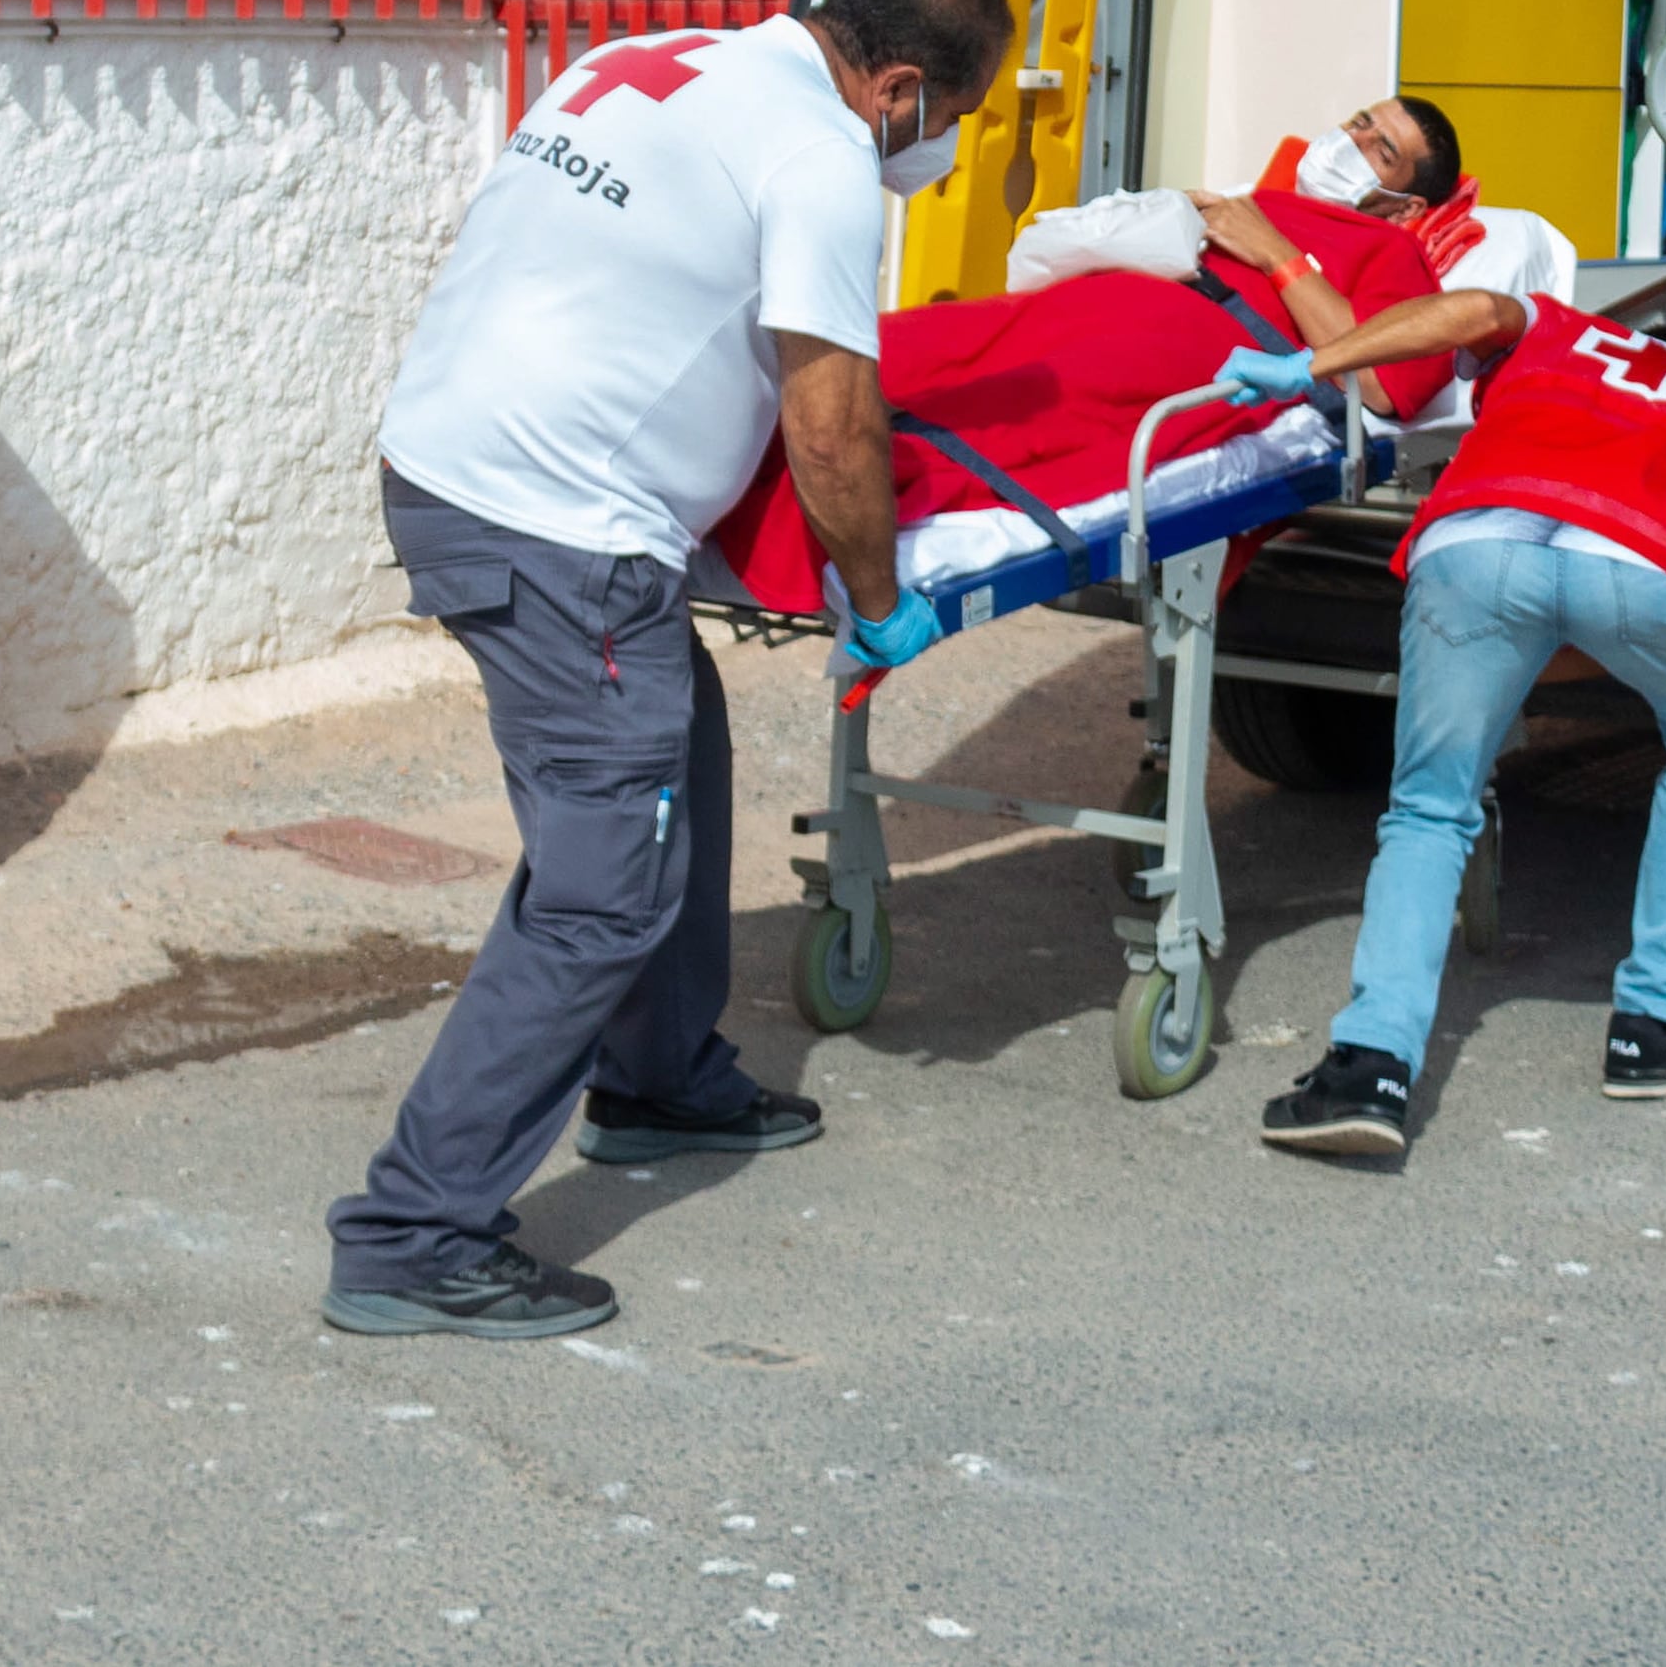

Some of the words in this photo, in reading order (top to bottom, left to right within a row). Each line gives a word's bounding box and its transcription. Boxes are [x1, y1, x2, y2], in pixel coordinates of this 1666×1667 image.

[504, 126, 545, 156] ruz
[539, 134, 631, 209] Roja
[1609, 1037, 1642, 1059] FILA
[1377, 1077, 1409, 1101] FILA
